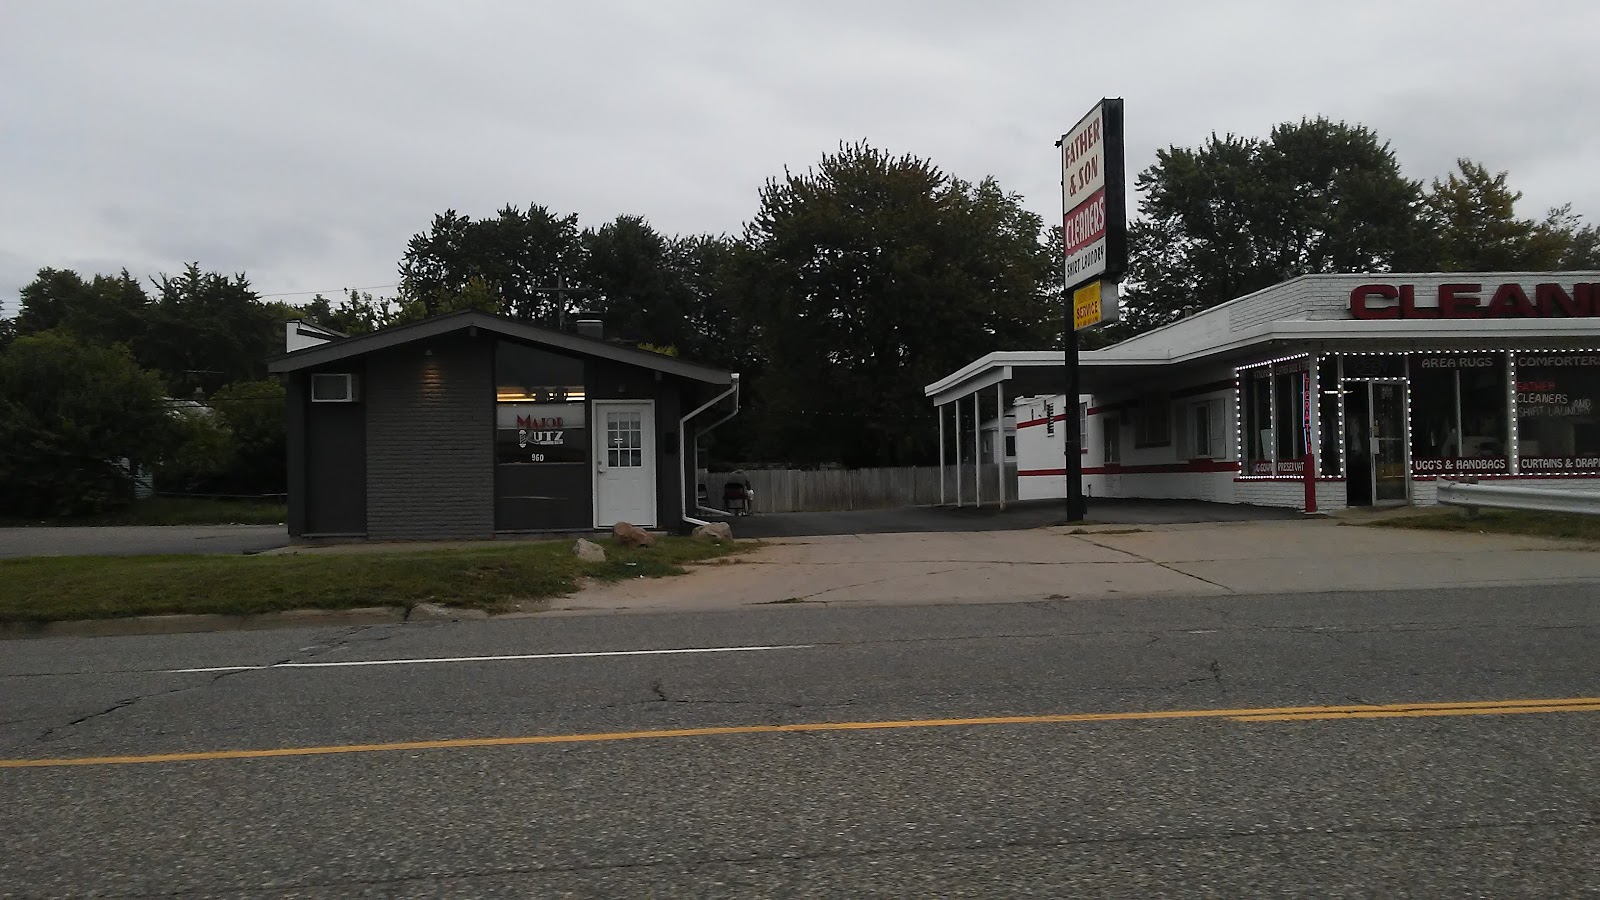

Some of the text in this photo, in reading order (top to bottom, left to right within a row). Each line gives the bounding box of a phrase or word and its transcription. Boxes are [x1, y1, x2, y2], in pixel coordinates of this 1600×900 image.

[1064, 117, 1100, 169] FATHER
[1069, 154, 1098, 198] & SON
[1066, 196, 1105, 249] CLEANERS
[1067, 245, 1105, 278] SHIRT LAUNDRY
[1350, 282, 1600, 320] CLEAN
[1076, 300, 1098, 320] SERVICE
[1421, 357, 1494, 368] AREA RUGS
[1517, 392, 1568, 405] CLEANERS
[1518, 406, 1544, 417] SHIRT
[531, 453, 545, 463] 960
[1415, 458, 1506, 470] UGG'S & HANDBAGS
[1521, 458, 1563, 469] CURTAINS
[1565, 458, 1574, 468] &
